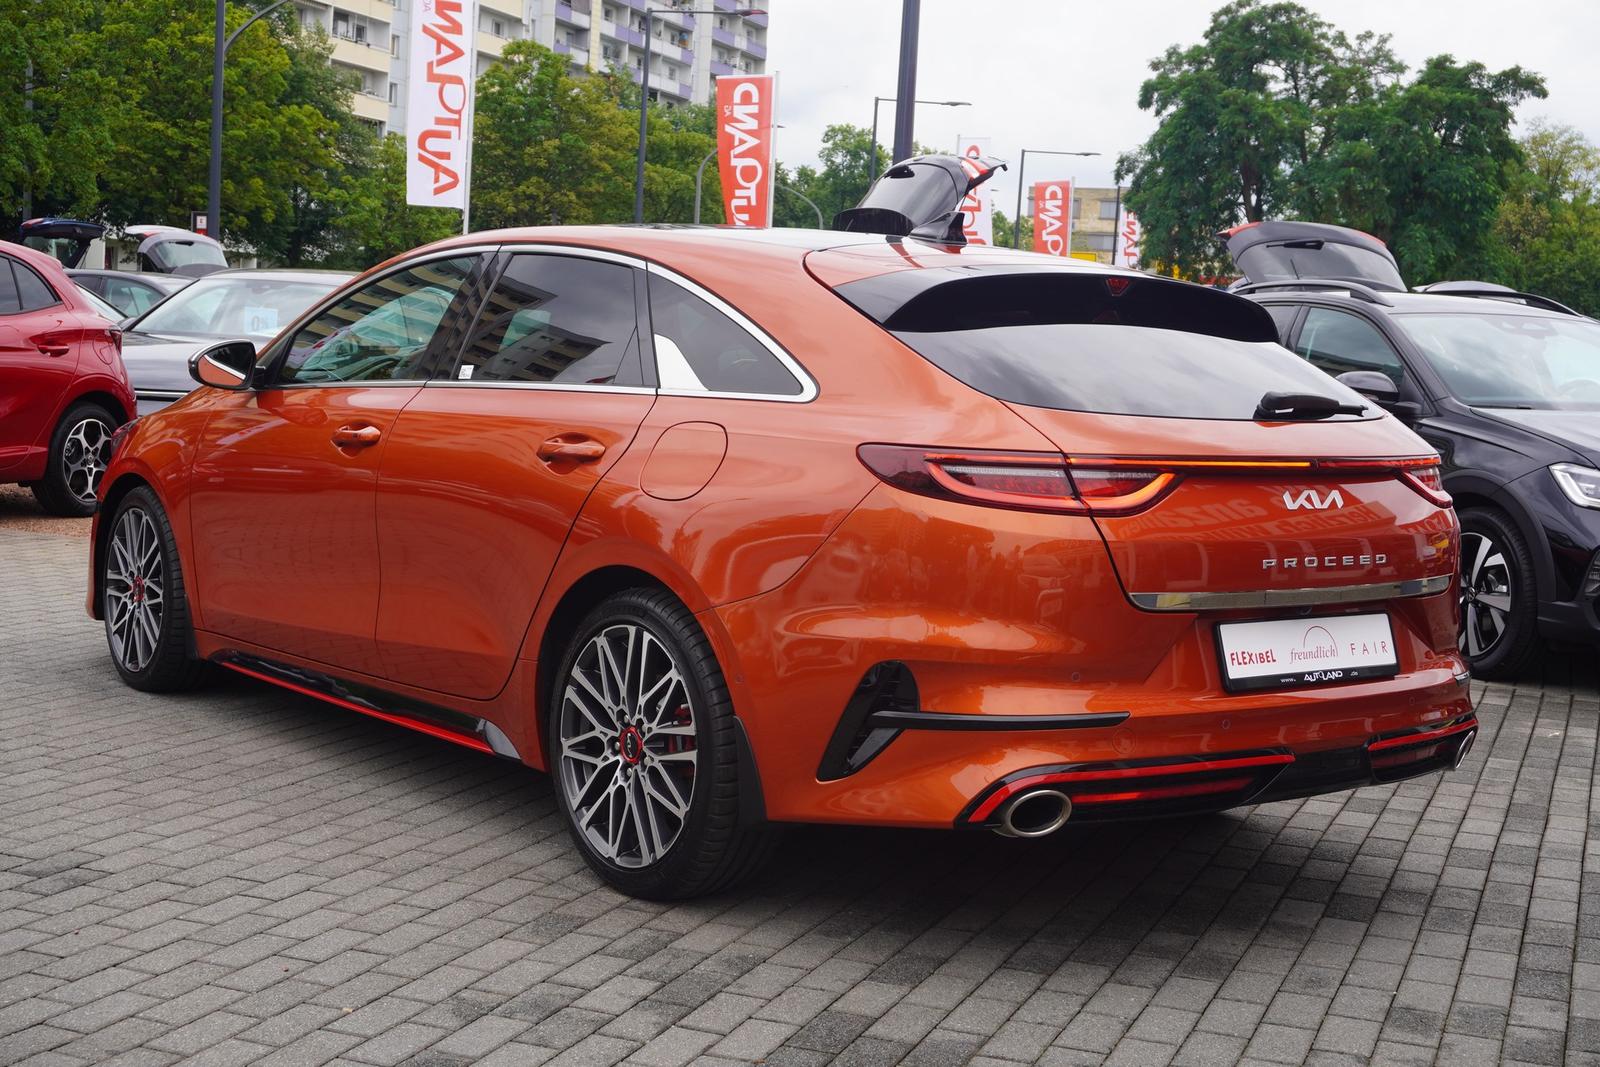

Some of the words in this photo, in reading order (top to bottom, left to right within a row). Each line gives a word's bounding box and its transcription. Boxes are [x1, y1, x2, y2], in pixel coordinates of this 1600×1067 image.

[1262, 554, 1387, 570] PROCEED
[1230, 649, 1276, 666] FLEXIBEL
[1289, 644, 1336, 664] freundlich
[1350, 641, 1388, 656] FAIR
[1303, 670, 1343, 682] AUTOLAND
